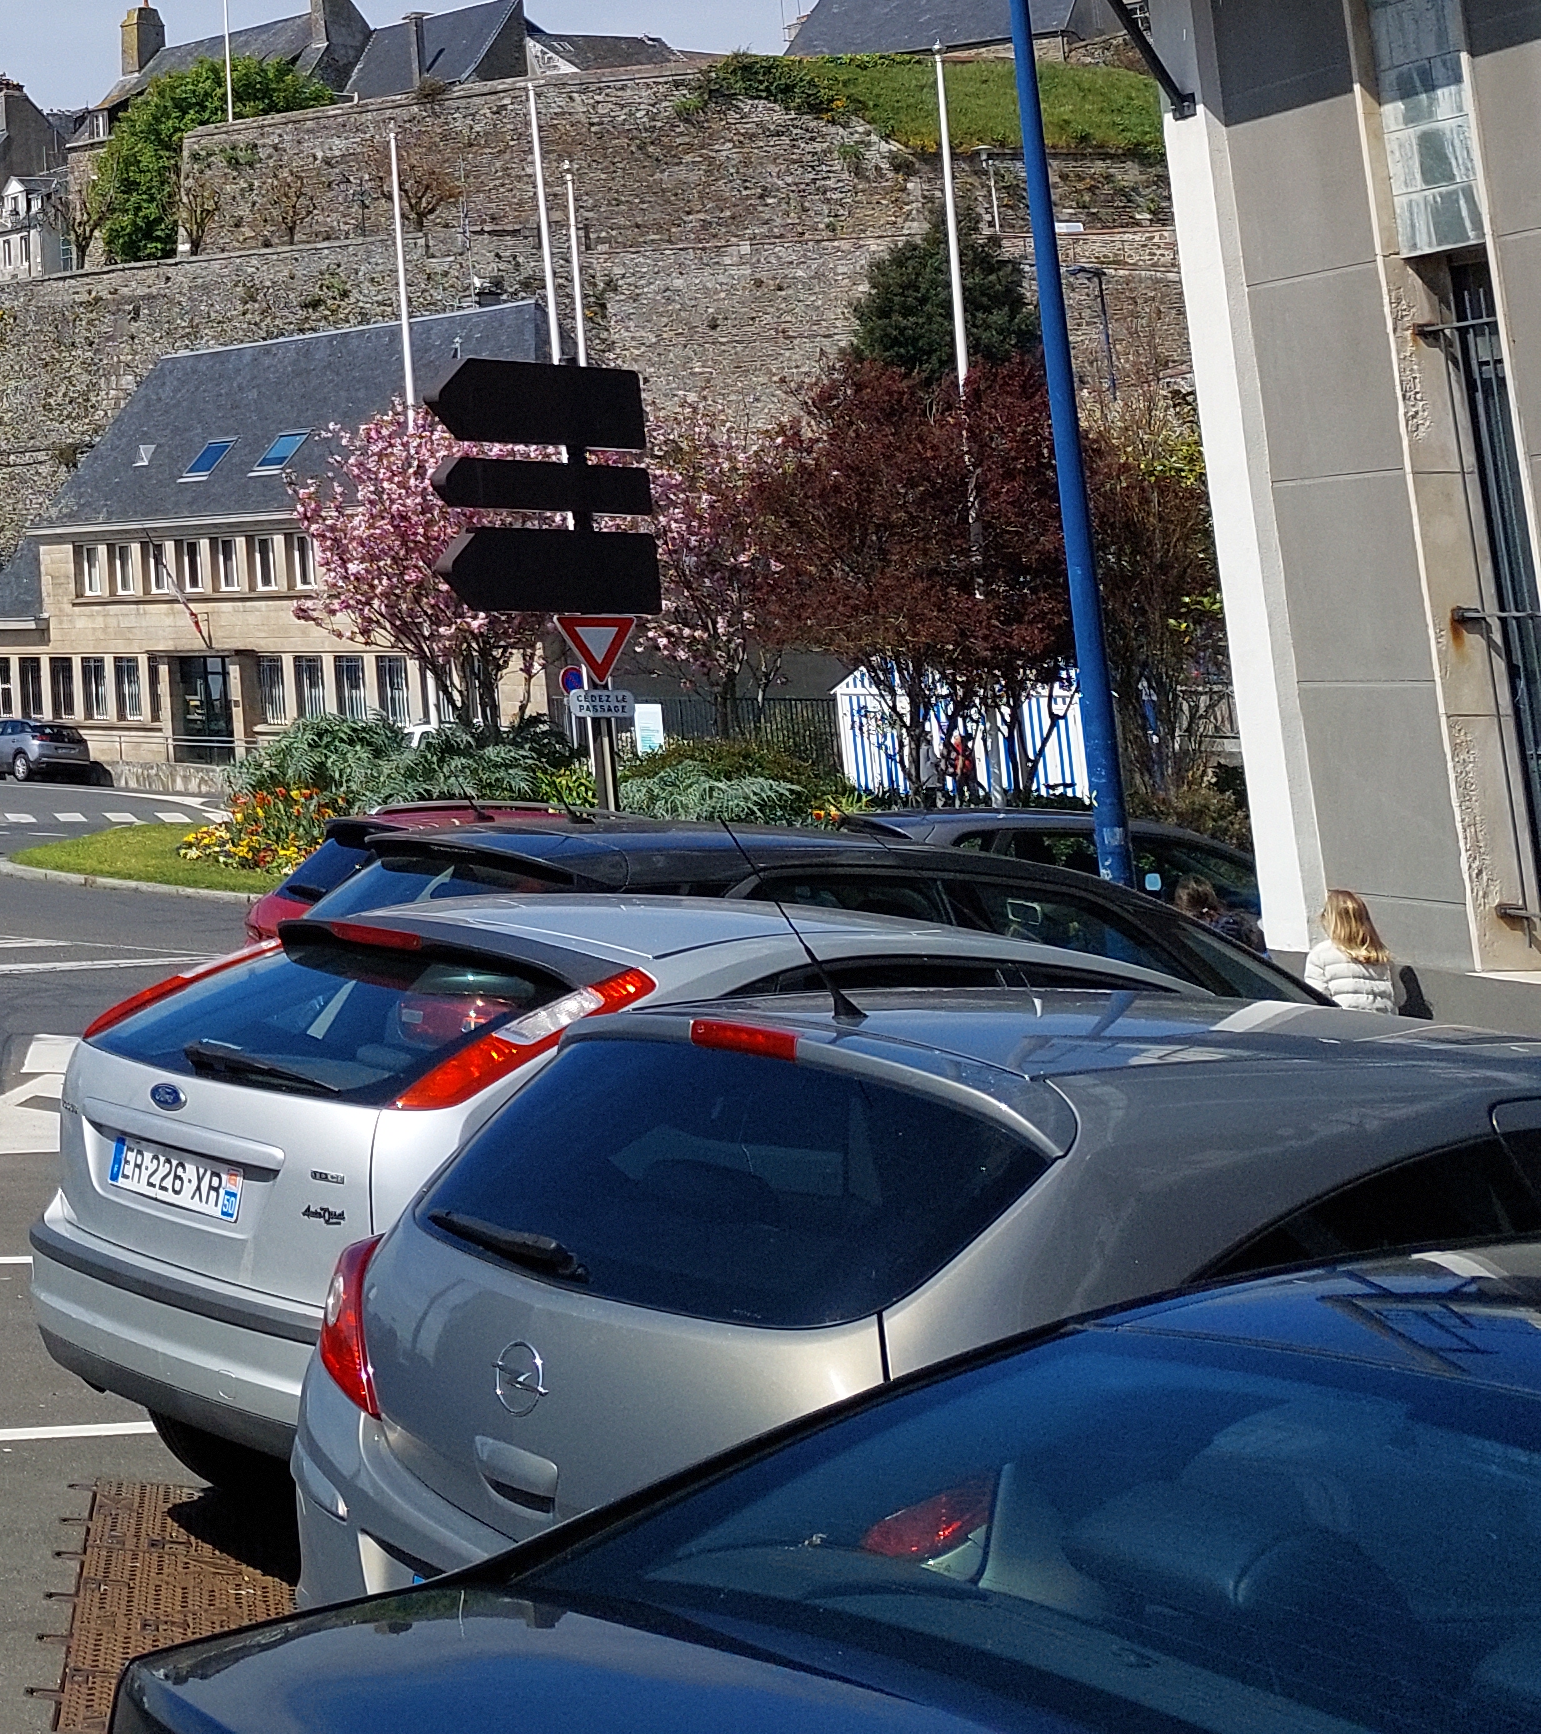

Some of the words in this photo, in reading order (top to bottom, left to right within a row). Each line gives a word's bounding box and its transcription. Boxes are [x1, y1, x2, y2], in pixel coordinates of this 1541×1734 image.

[579, 705, 627, 713] PASSAGE
[120, 1145, 223, 1208] ER-226-XR
[222, 1194, 237, 1215] 50
